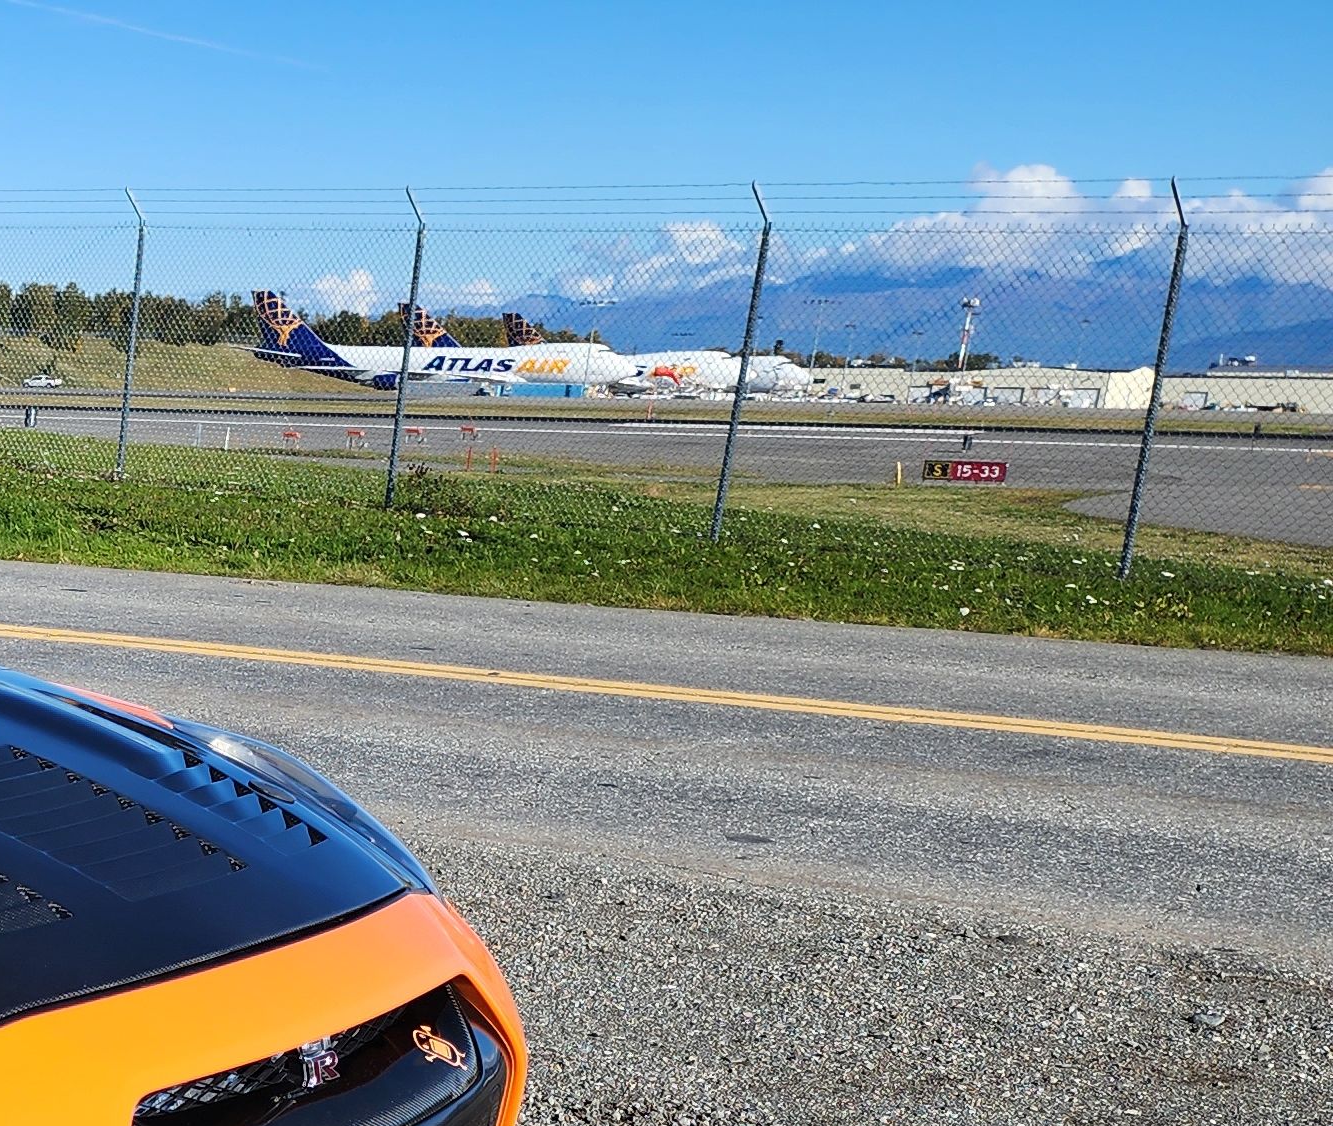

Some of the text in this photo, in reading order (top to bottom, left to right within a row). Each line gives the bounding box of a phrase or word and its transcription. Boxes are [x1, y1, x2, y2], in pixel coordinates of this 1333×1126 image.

[421, 355, 572, 375] ATLAS AIR
[956, 464, 1000, 478] 15-33
